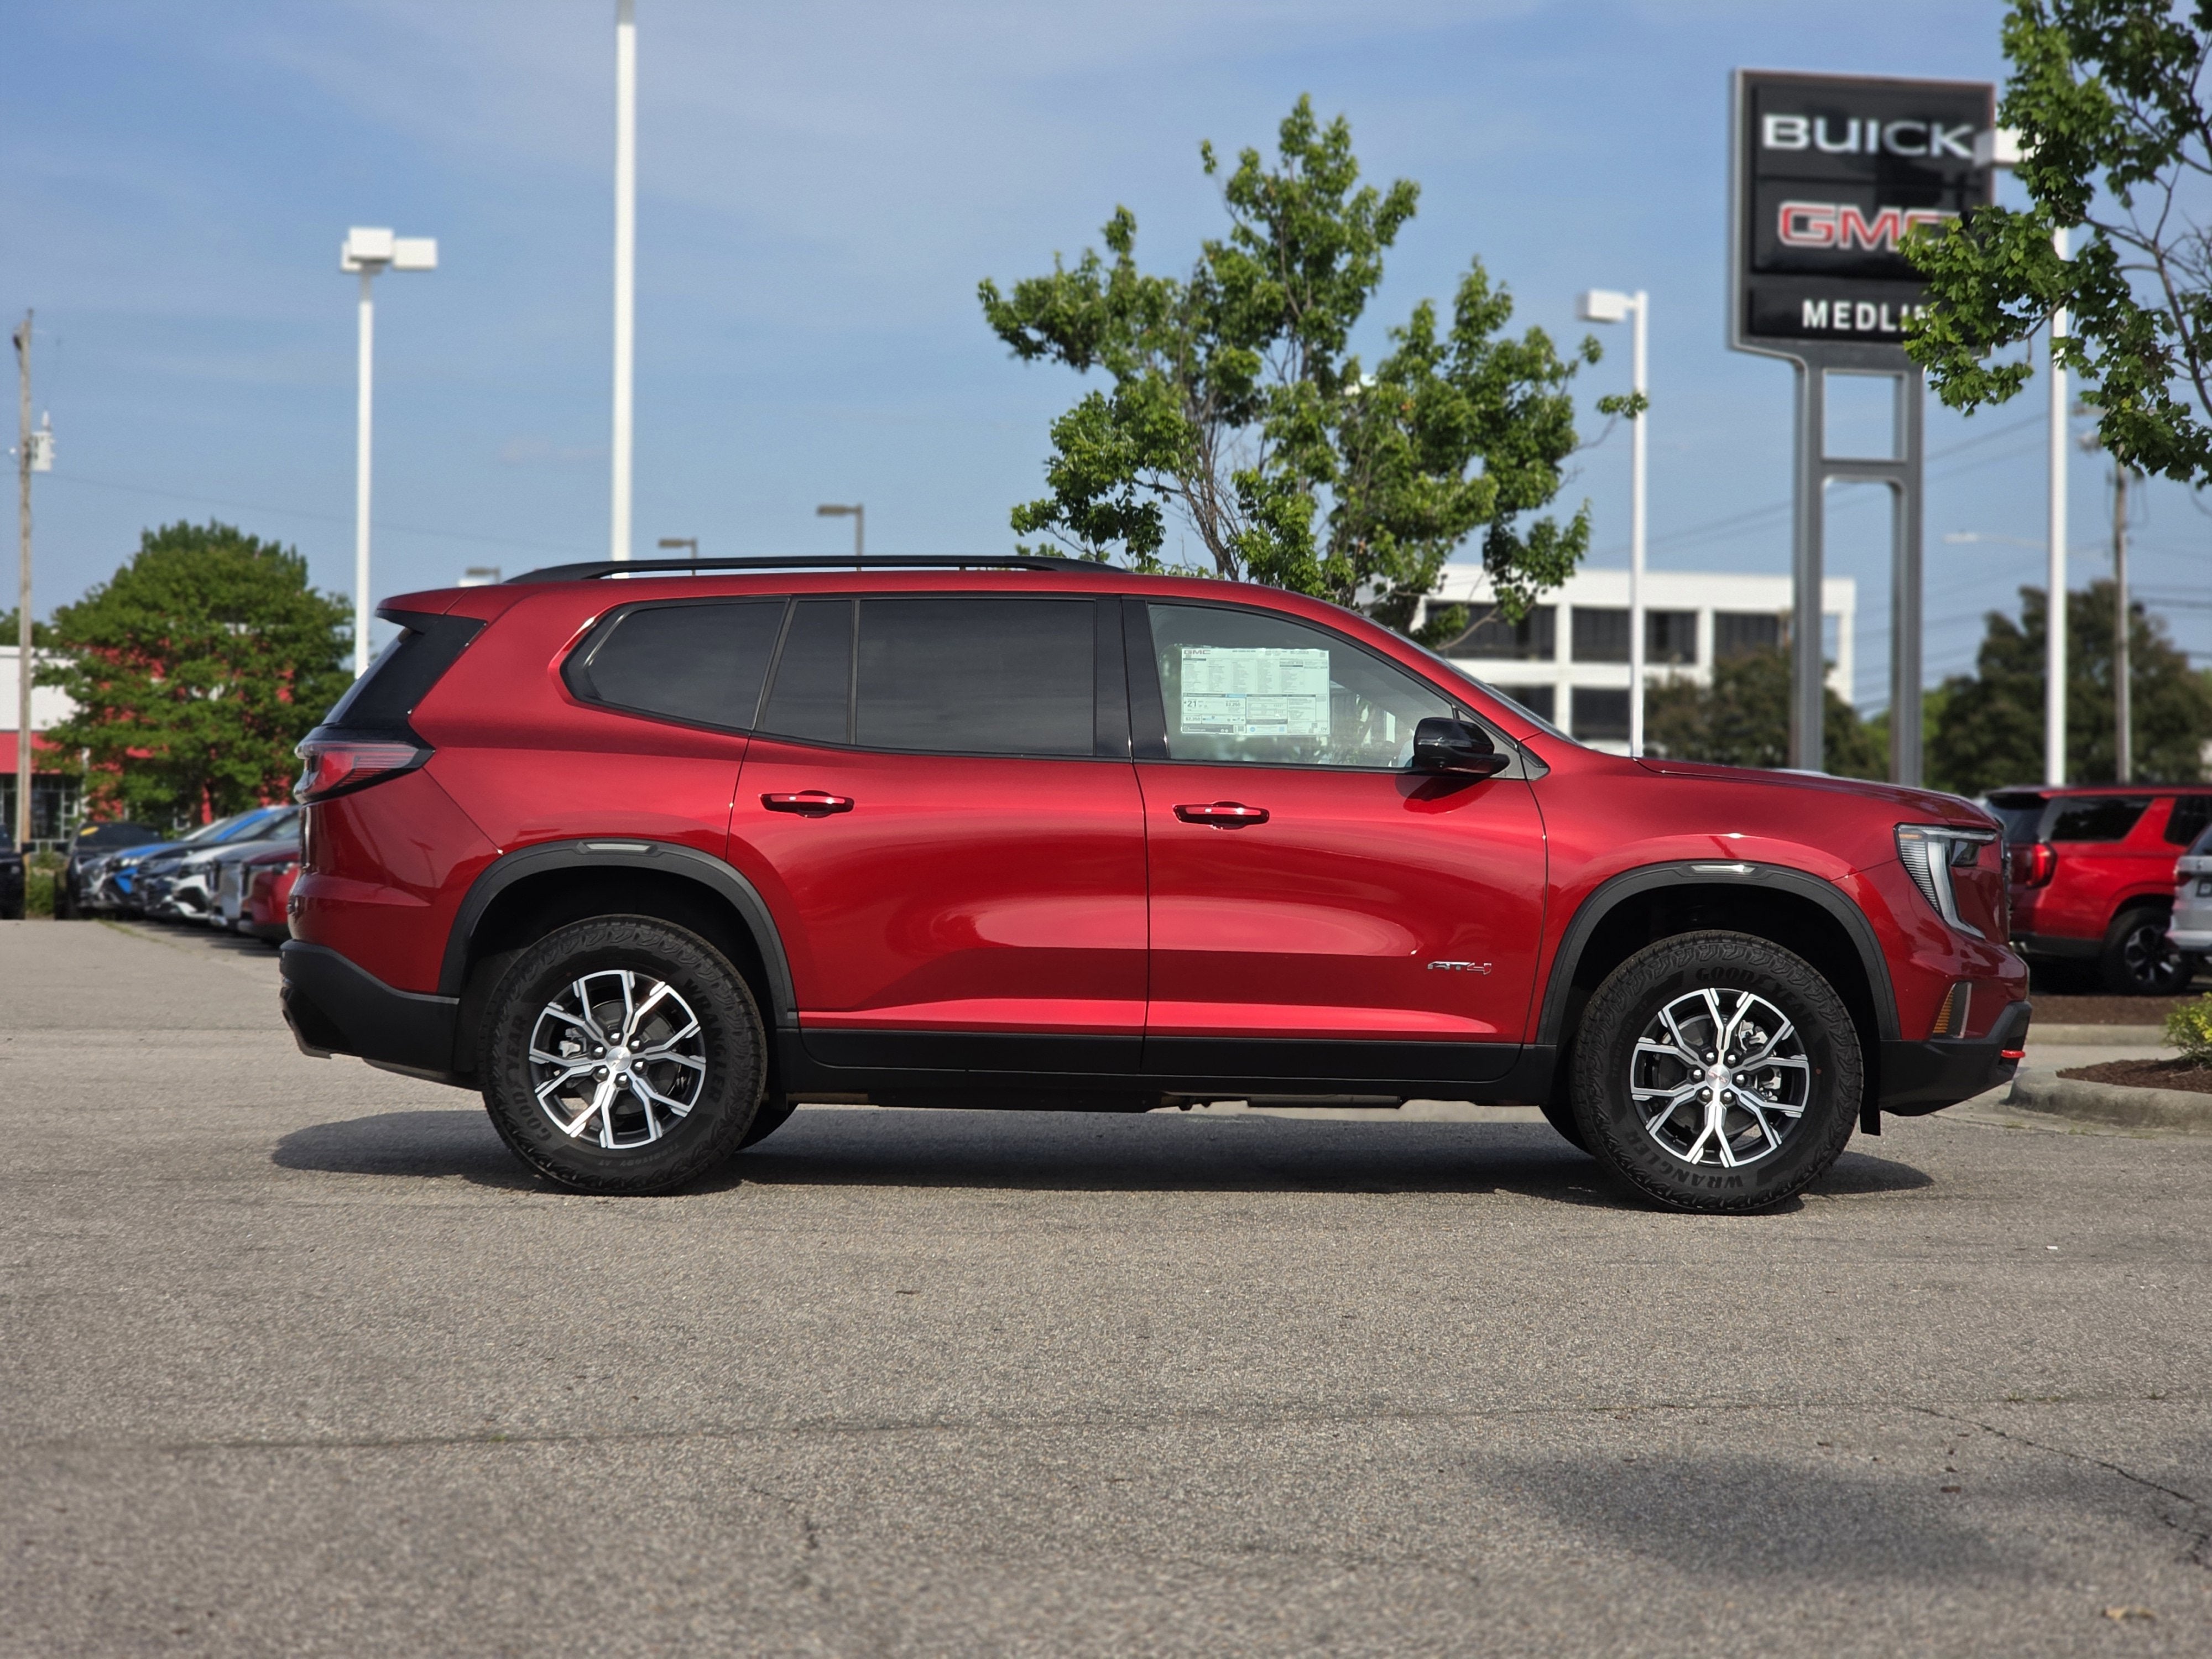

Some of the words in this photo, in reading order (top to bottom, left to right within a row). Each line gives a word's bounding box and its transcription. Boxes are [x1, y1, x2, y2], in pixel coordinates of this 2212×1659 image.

[1762, 114, 1974, 158] BUICK
[682, 978, 727, 1103] WRANGLER
[1625, 1130, 1744, 1188] WRANGLER
